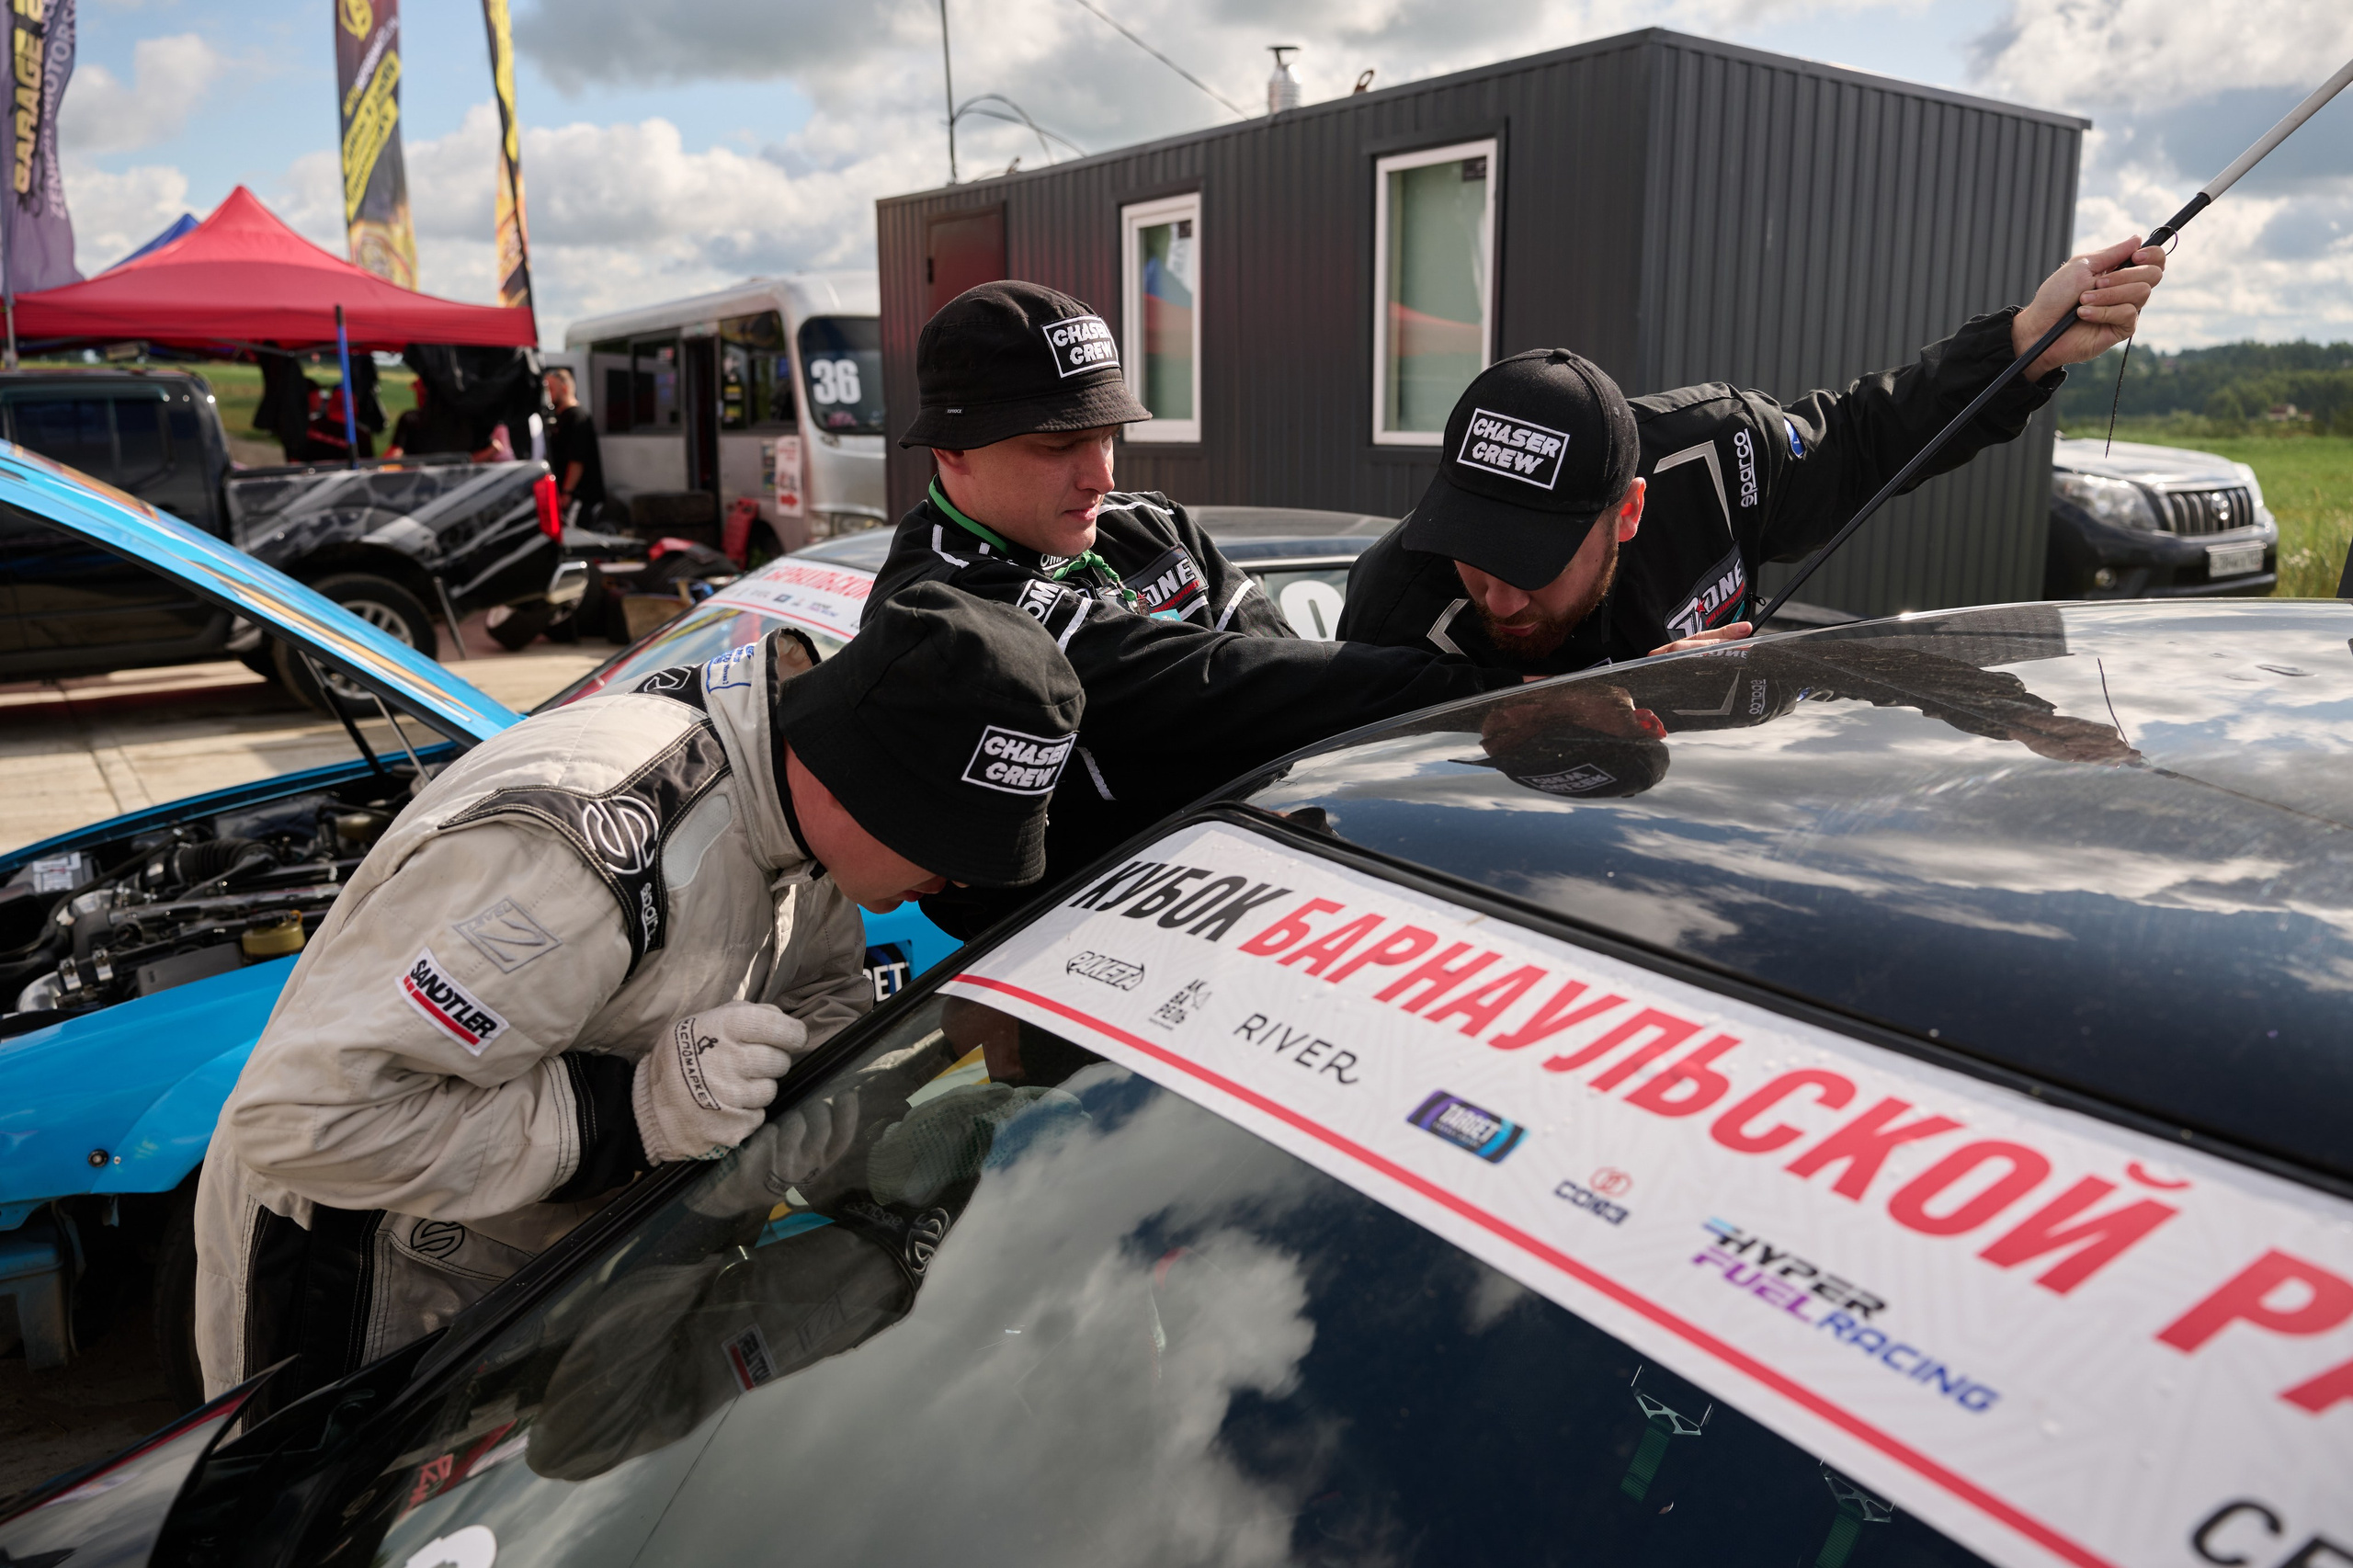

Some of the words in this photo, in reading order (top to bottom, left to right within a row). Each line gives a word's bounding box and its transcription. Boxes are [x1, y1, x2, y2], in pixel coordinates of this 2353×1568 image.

[14, 28, 43, 194] GARAGE
[1069, 340, 1113, 365] CREW
[810, 358, 861, 404] 36
[1472, 417, 1562, 459] CHASER
[1472, 441, 1544, 475] CREW
[1733, 428, 1758, 508] sparco
[983, 735, 1070, 766] CHASER
[985, 761, 1057, 788] CREW
[410, 959, 497, 1040] SANDTLER
[1233, 1012, 1358, 1085] RIVER
[1067, 860, 1295, 942] КУБОК
[1236, 897, 2193, 1297] БАРНАУЛЬСКОЙ
[1438, 1102, 1502, 1143] TARGET
[1711, 1224, 1889, 1320] HYPER
